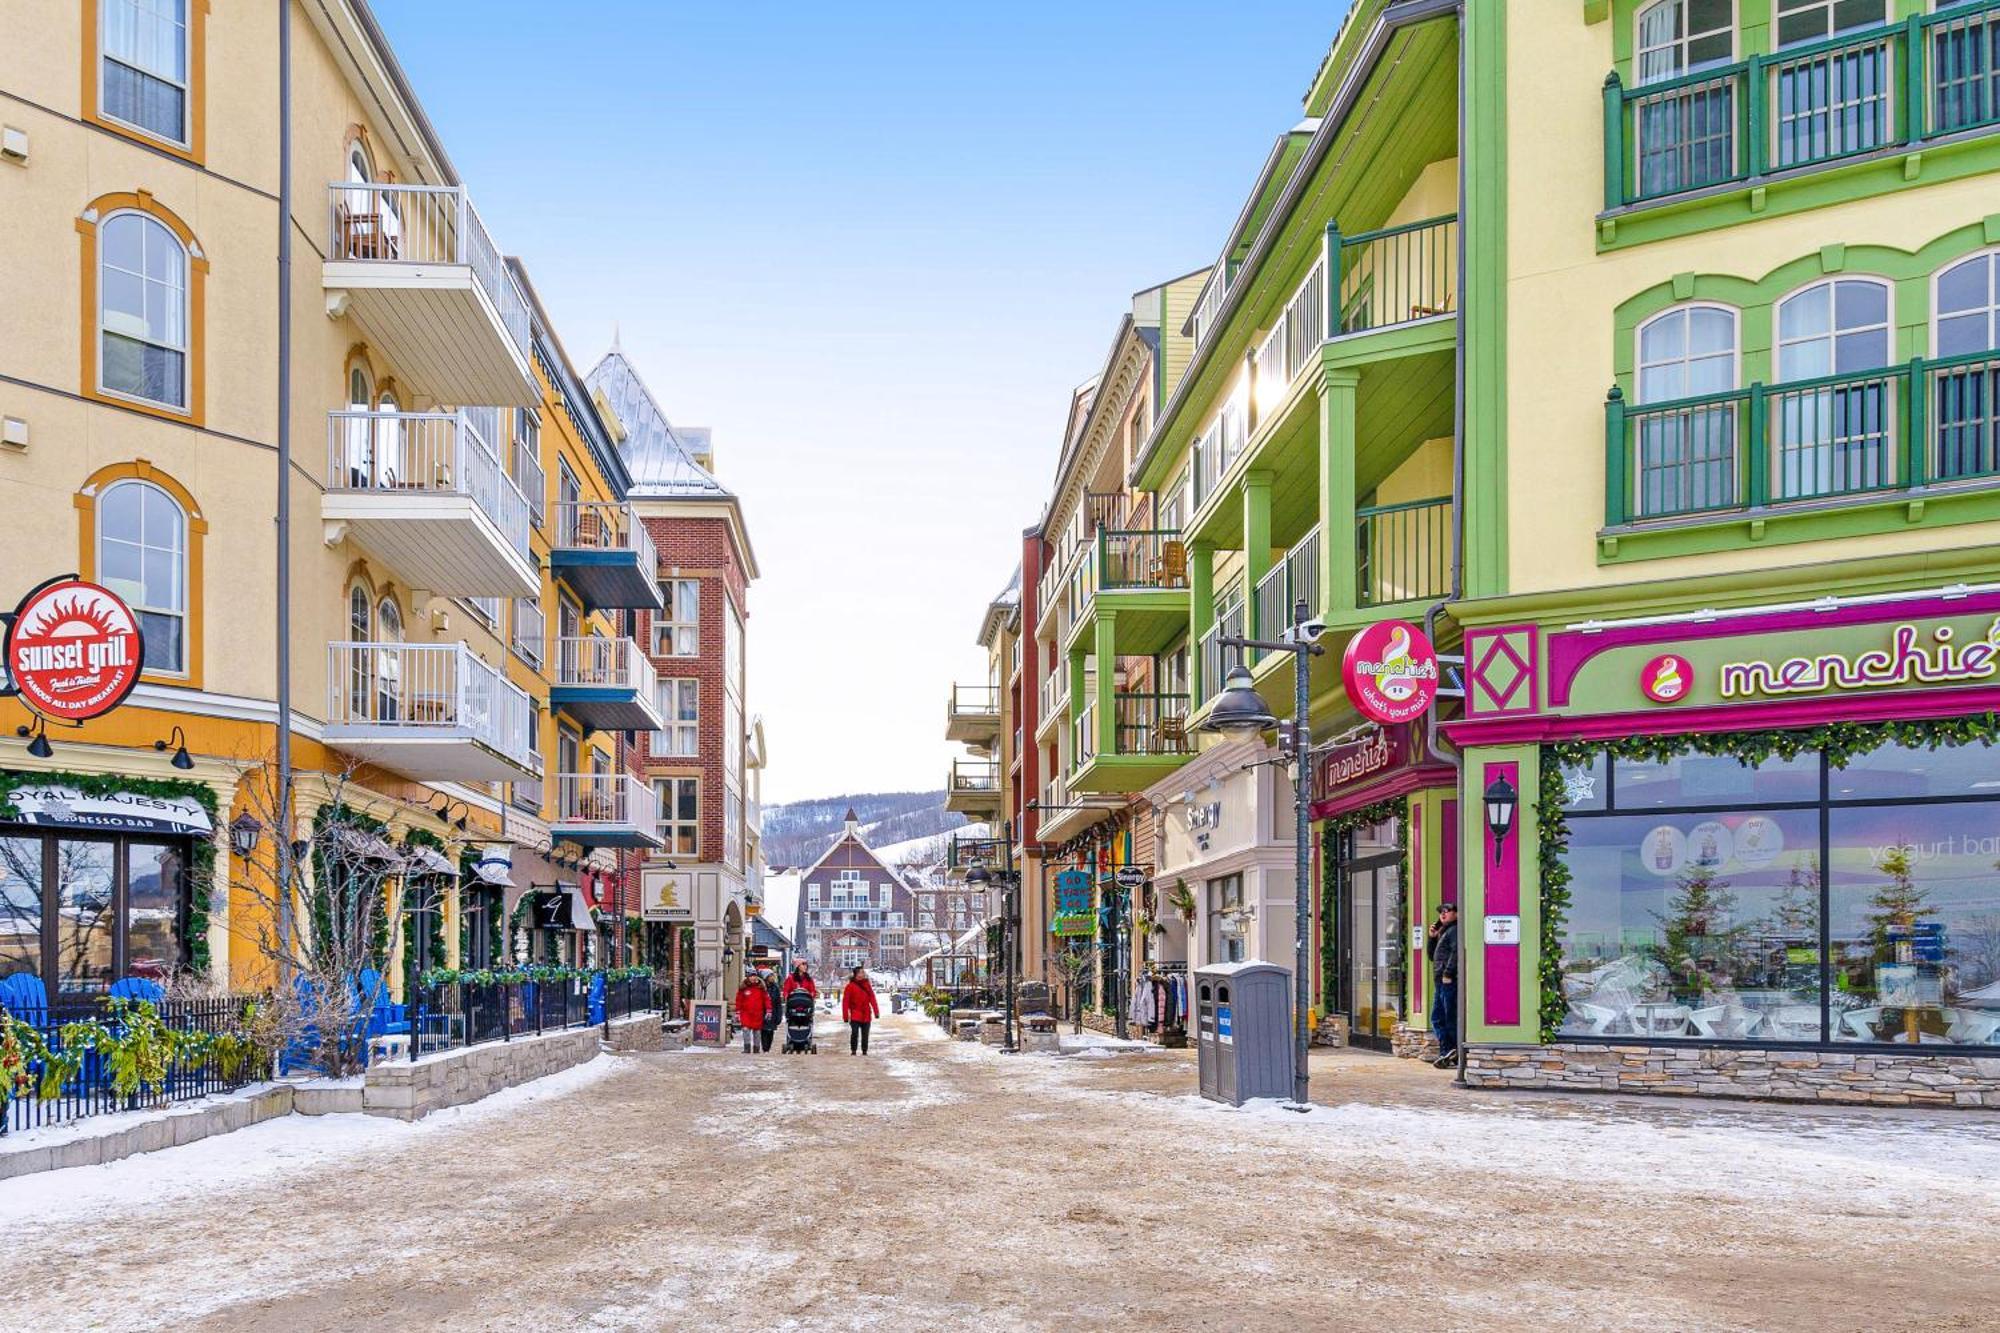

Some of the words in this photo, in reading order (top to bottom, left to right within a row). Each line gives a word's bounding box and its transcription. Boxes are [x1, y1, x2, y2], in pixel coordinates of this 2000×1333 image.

[18, 640, 84, 671] sunset
[88, 636, 126, 674] grill
[1356, 655, 1437, 680] menchie's
[1721, 626, 2000, 697] menchie
[25, 675, 52, 703] FAMOUS
[51, 700, 67, 709] ALL
[68, 701, 87, 709] DAY
[87, 669, 125, 706] BREAKFAST
[1363, 687, 1389, 714] what's
[1389, 708, 1410, 719] your
[1410, 689, 1430, 713] mix?
[1329, 728, 1389, 786] menchie's
[81, 791, 199, 816] MAJESTY
[126, 819, 155, 828] BAR
[1868, 835, 1957, 868] yogurt
